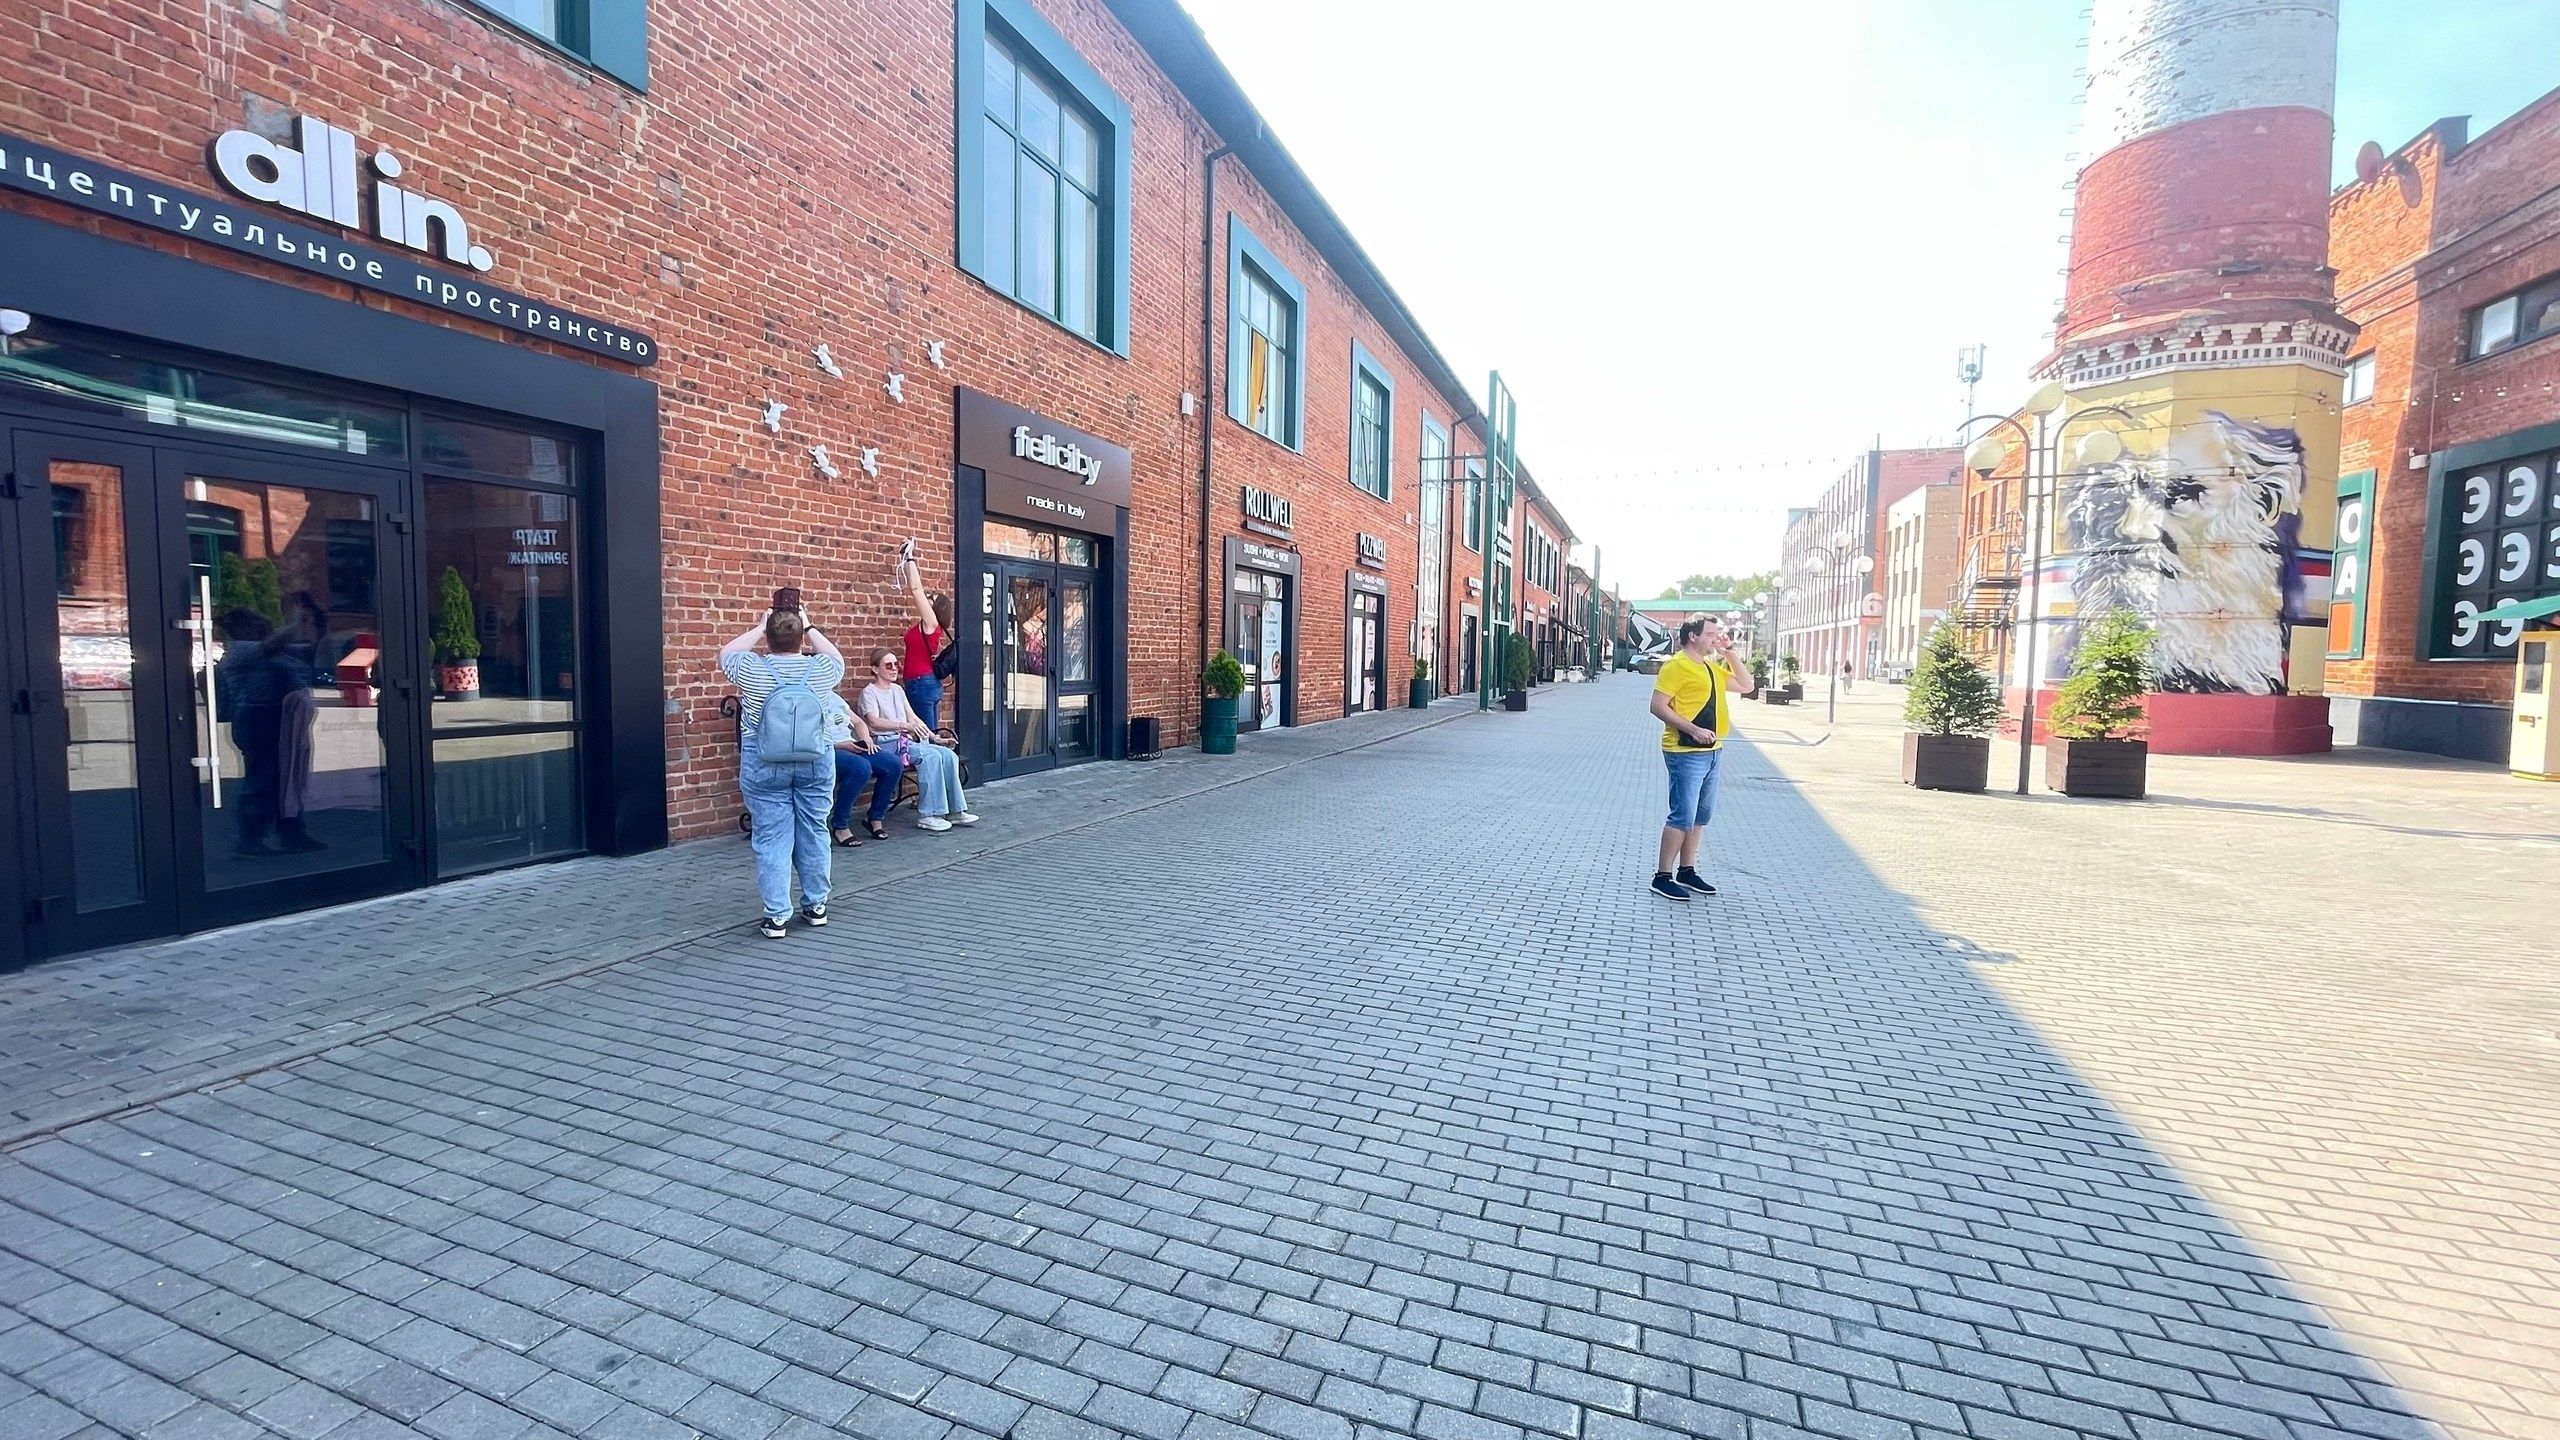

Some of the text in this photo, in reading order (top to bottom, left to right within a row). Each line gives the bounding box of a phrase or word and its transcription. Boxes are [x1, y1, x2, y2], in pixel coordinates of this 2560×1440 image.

[211, 114, 494, 273] all in.
[0, 148, 650, 358] цептуальное пространство
[1014, 425, 1102, 486] felicity
[1026, 495, 1086, 520] made in Italy
[1245, 485, 1294, 530] ROLLWELL
